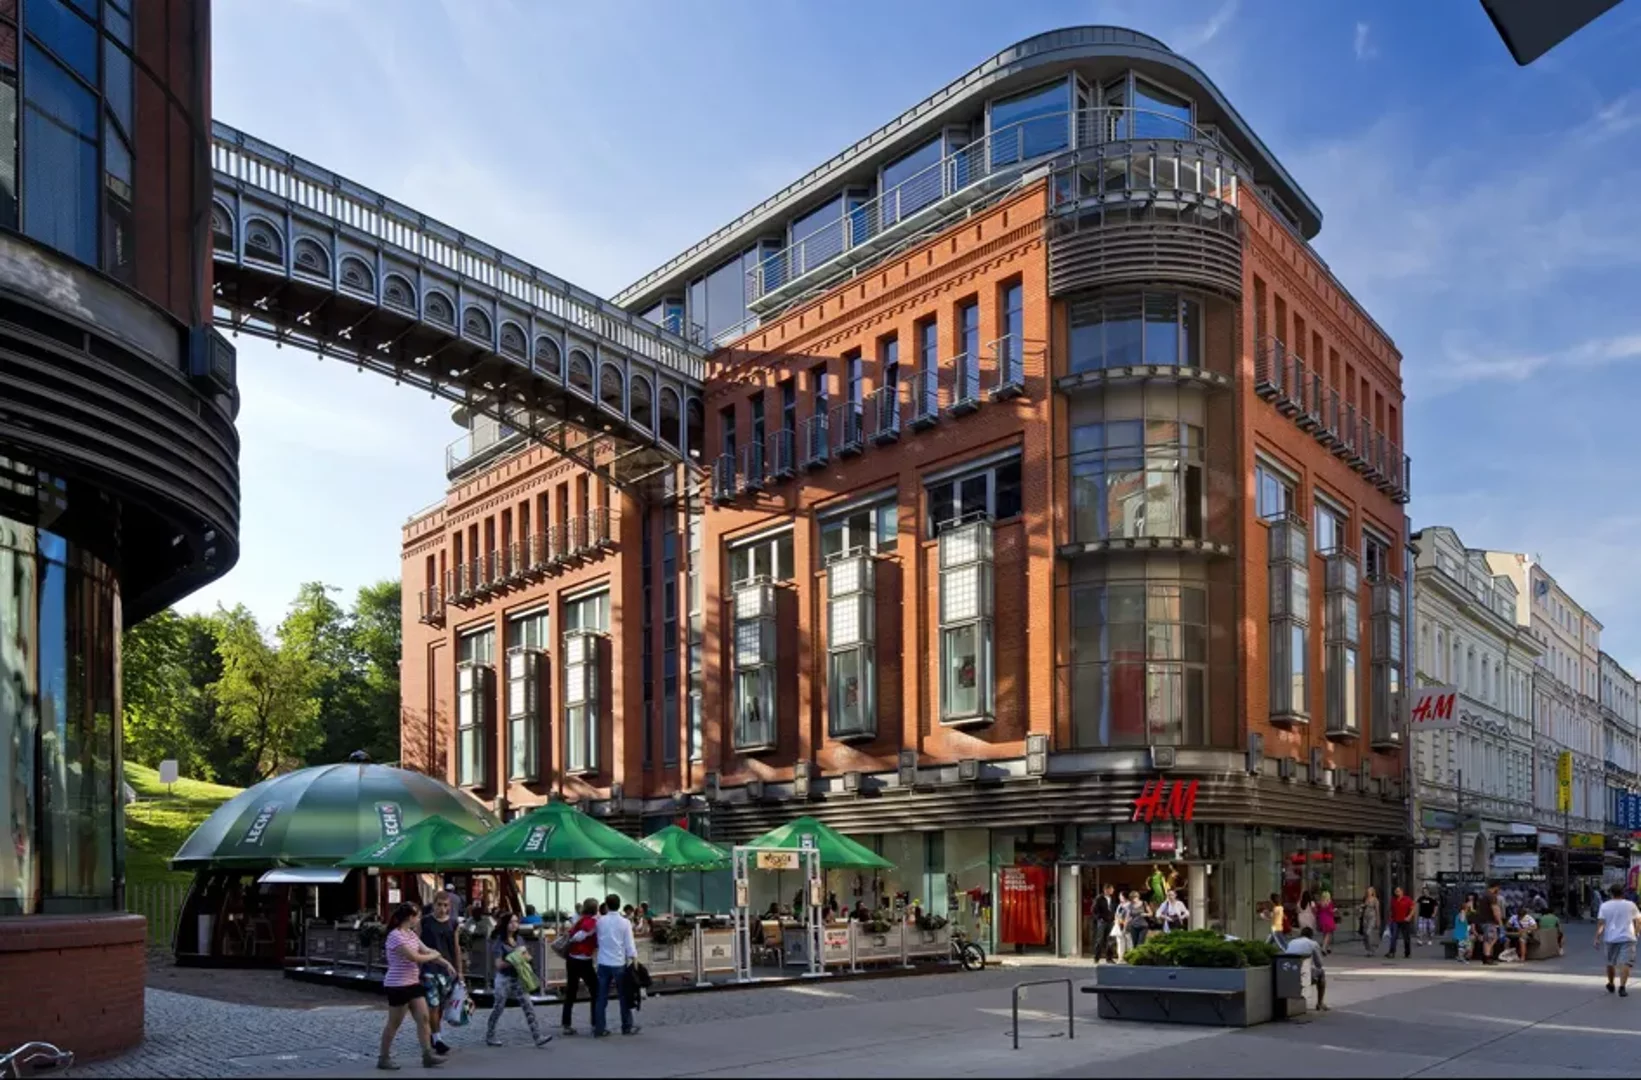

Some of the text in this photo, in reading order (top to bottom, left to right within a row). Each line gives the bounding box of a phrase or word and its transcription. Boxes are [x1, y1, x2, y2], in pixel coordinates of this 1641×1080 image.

[1411, 692, 1456, 723] H&M
[1131, 776, 1199, 823] H&M
[245, 814, 272, 843] LECH
[383, 814, 399, 836] ECH
